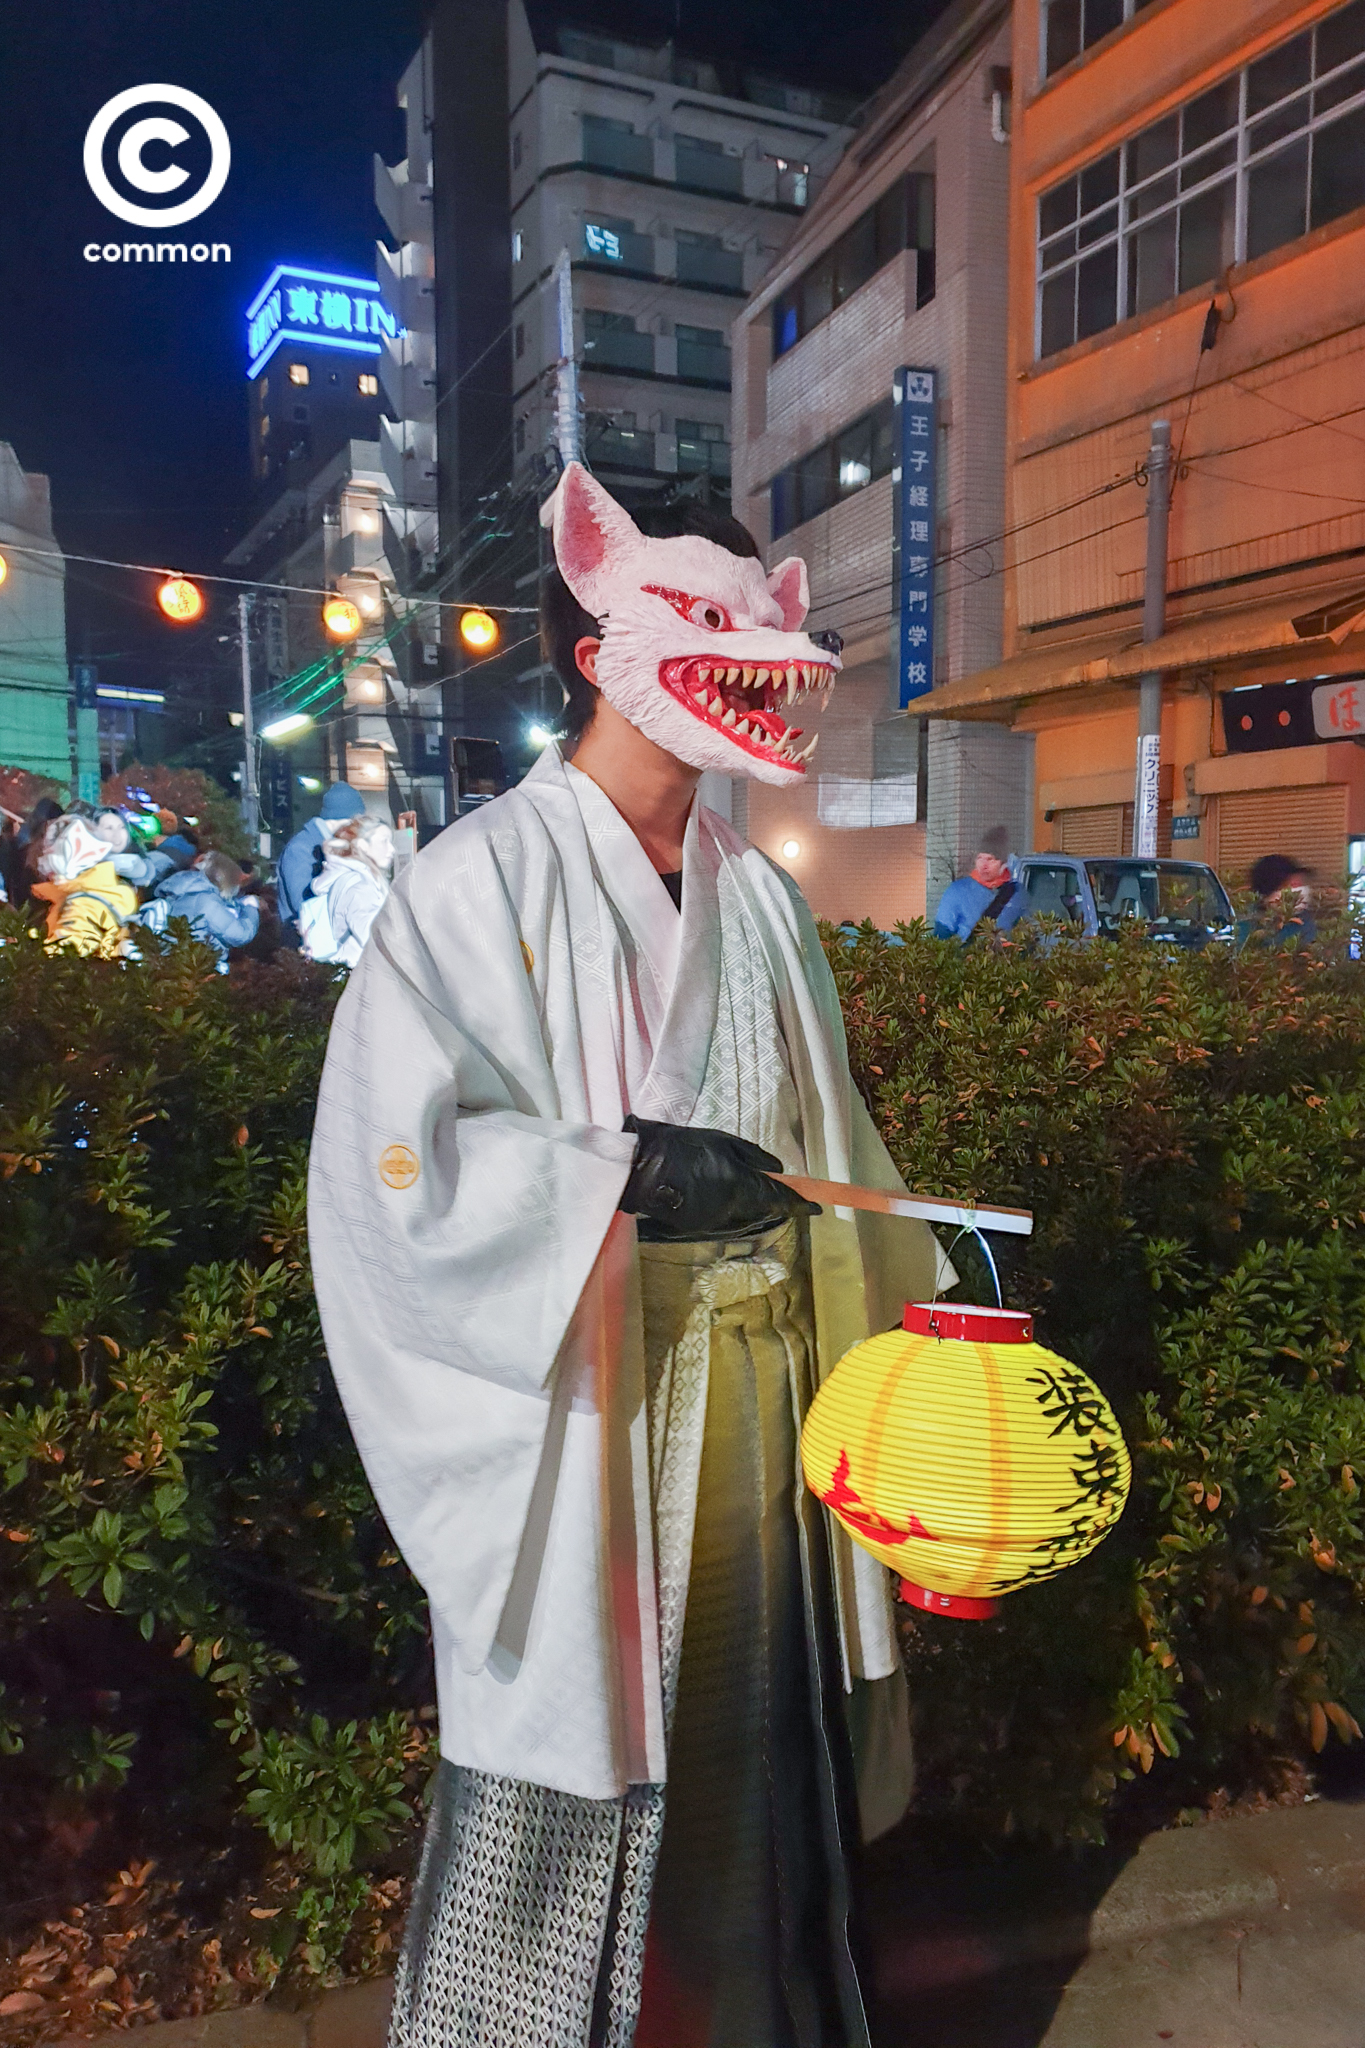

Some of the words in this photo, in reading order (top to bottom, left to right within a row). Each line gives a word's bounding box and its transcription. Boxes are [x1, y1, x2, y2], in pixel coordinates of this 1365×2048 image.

[286, 285, 408, 340] 東横IN
[908, 415, 930, 685] 王子経理専門学校
